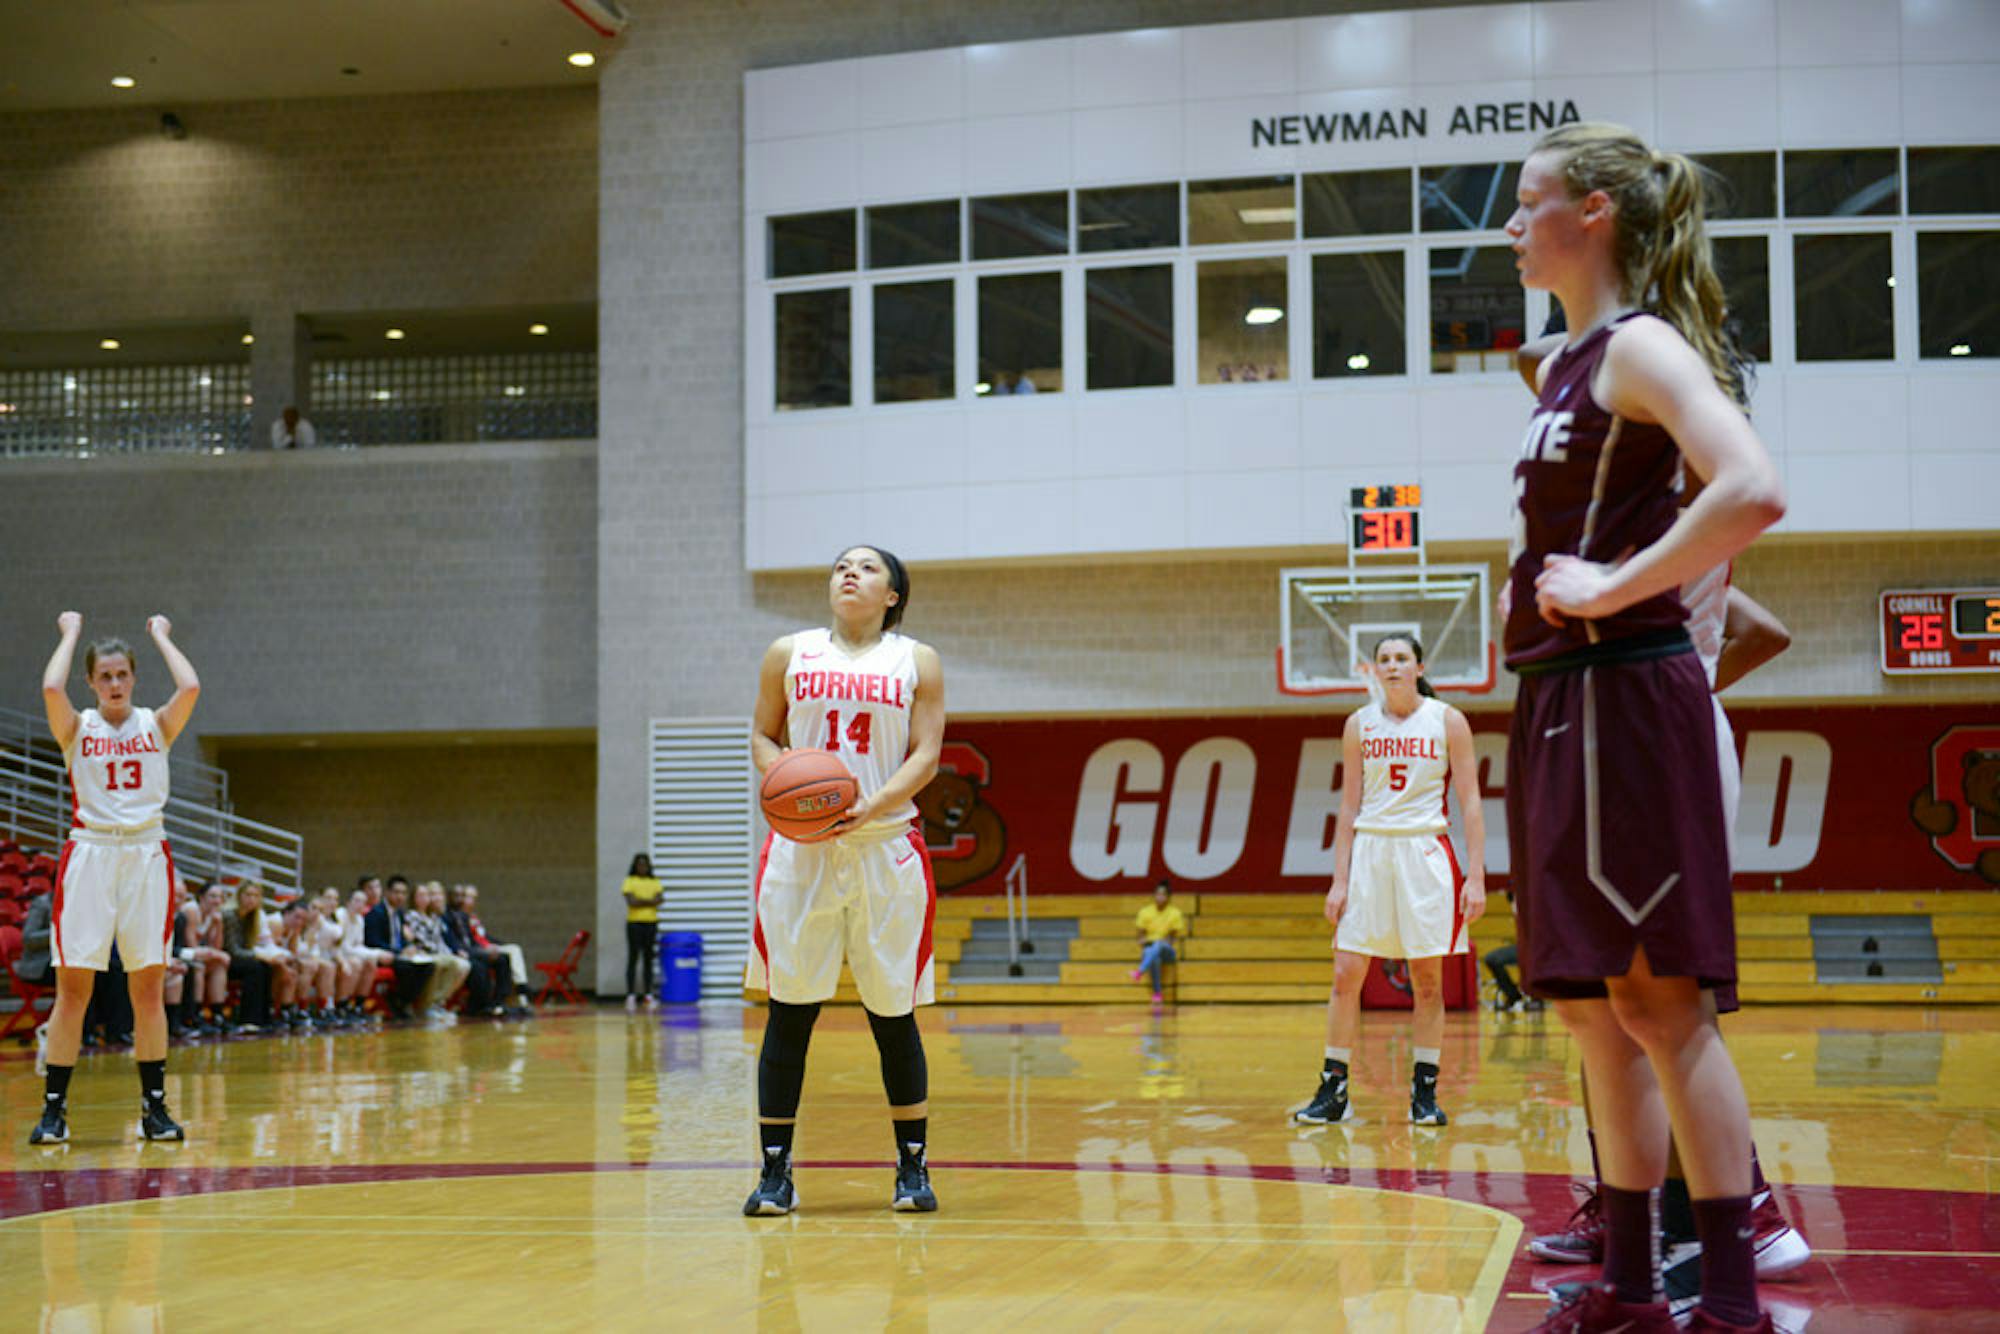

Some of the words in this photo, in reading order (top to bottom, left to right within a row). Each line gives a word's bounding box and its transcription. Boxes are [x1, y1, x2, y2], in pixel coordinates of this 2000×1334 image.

[1251, 108, 1428, 148] NEWMAN
[1448, 99, 1582, 136] ARENA
[1361, 511, 1412, 549] 30
[1888, 596, 1945, 614] CORNELL
[1900, 615, 1944, 649] 26
[795, 669, 905, 709] CORNELL
[81, 732, 161, 758] CORNELL
[825, 709, 872, 755] 14
[1361, 736, 1439, 761] CORNELL
[105, 760, 143, 791] 13
[1389, 763, 1408, 792] 5
[1069, 736, 1257, 881] GO
